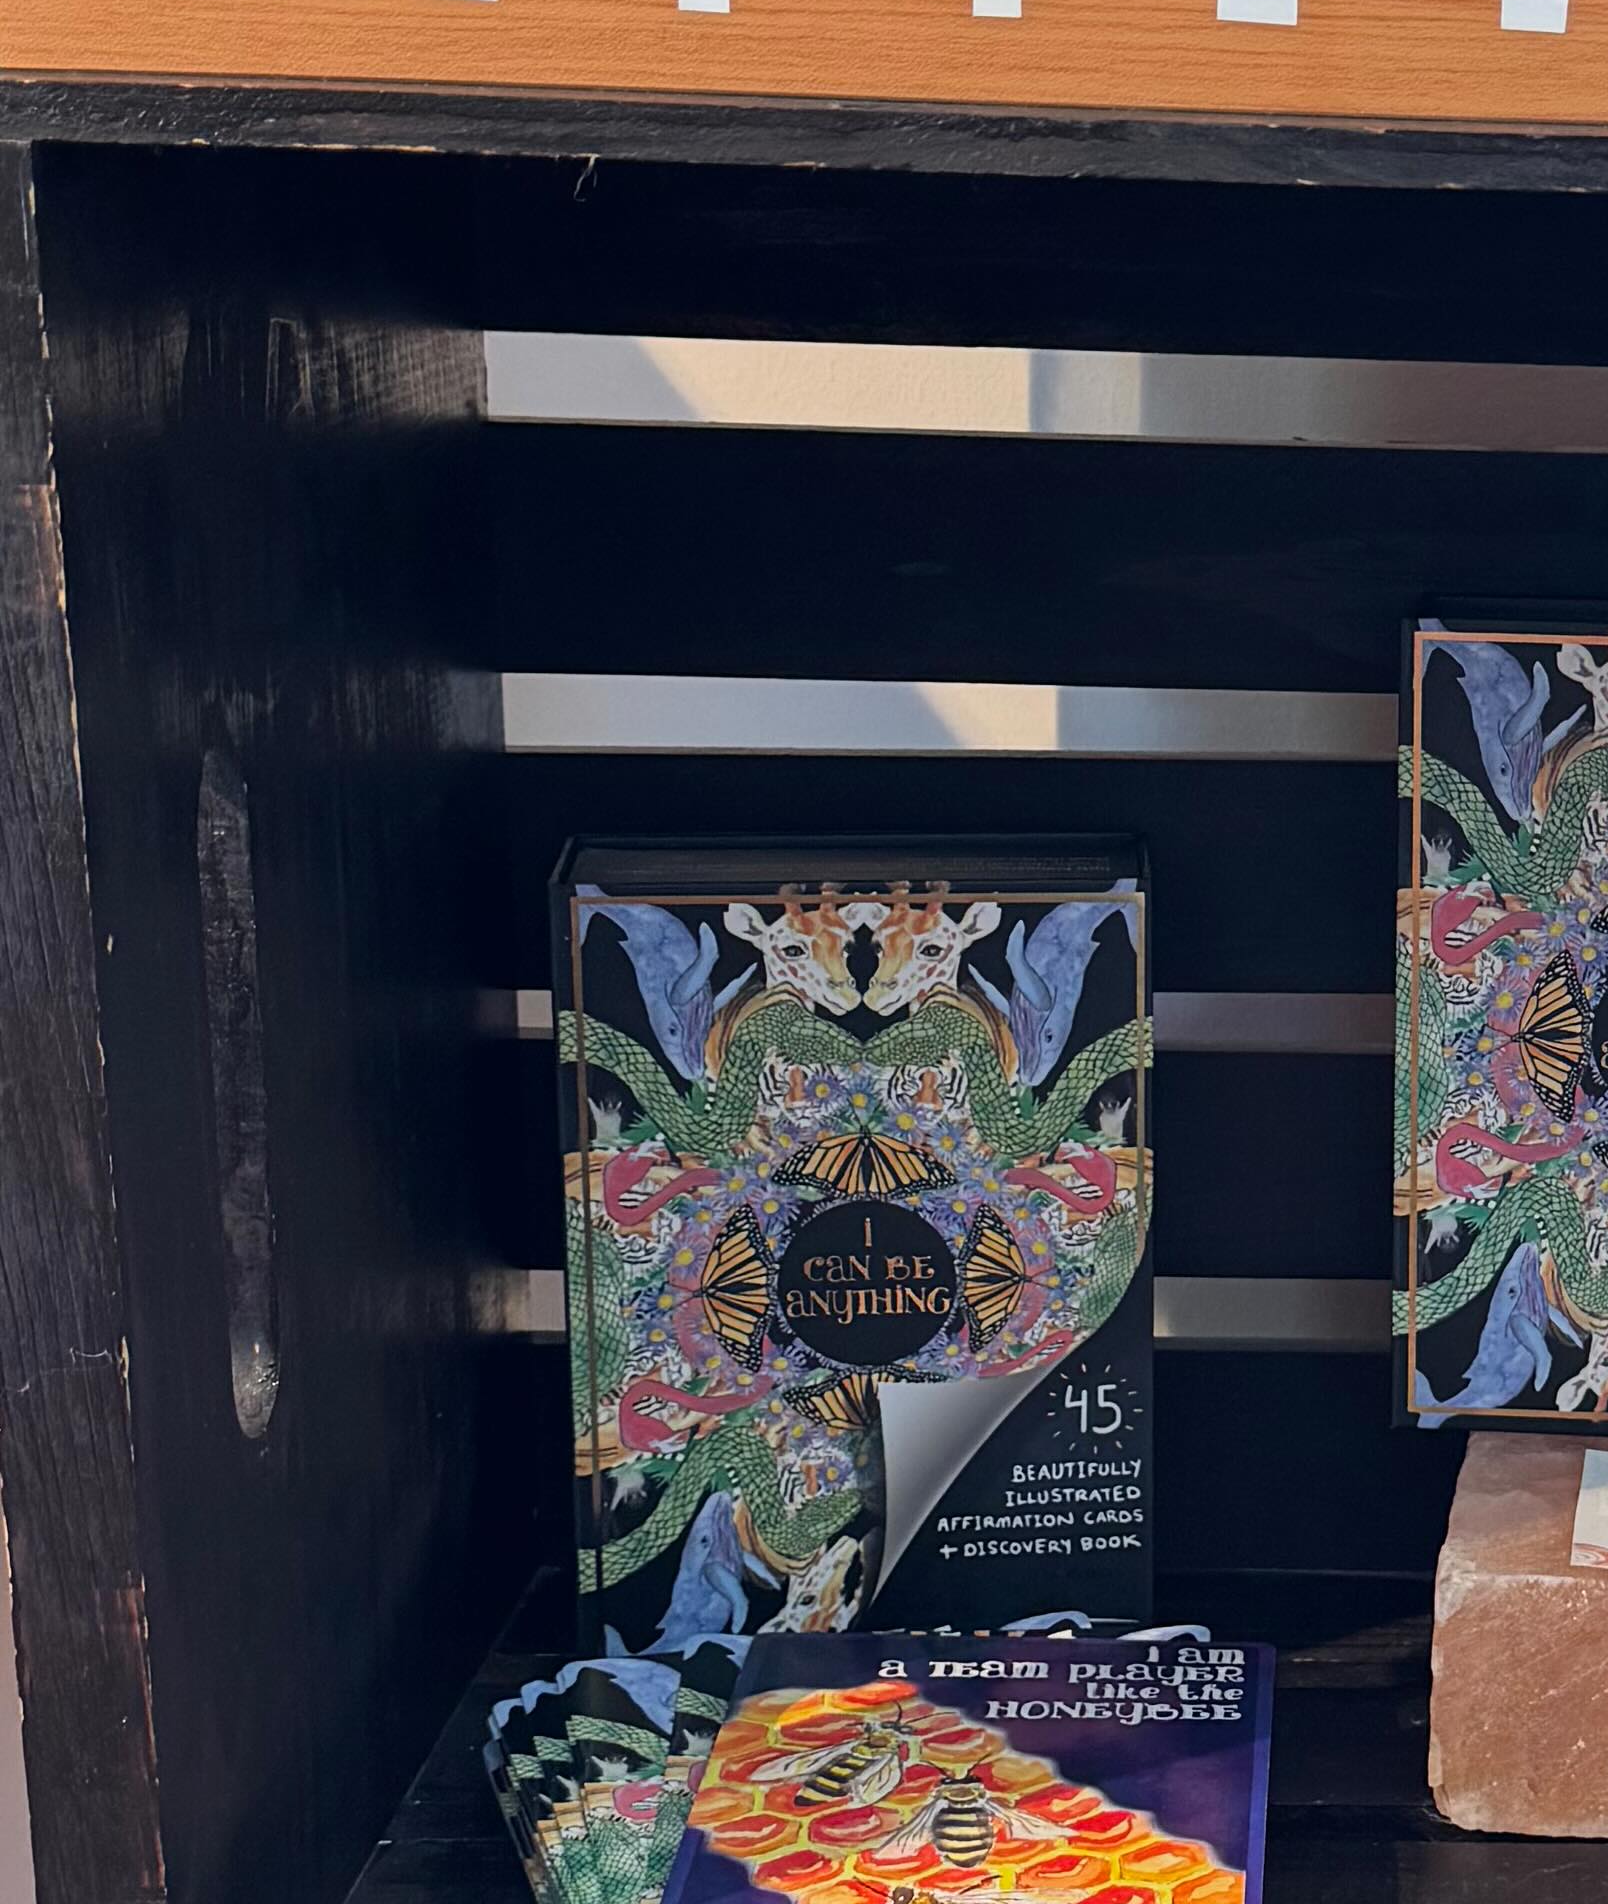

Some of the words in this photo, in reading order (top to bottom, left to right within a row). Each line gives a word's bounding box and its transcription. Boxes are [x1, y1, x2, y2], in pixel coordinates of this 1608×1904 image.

[886, 1256, 934, 1280] BE
[1065, 1384, 1121, 1434] 45
[1012, 1459, 1141, 1482] BEAUTIFULLY
[1006, 1486, 1140, 1506] ILLUSTRATED
[938, 1512, 1074, 1531] AFFIRMATION
[1084, 1509, 1143, 1524] CARDS
[964, 1539, 1071, 1556] DISCOVERY
[1081, 1535, 1141, 1551] BOOK
[878, 1660, 907, 1678] a
[1086, 1683, 1159, 1700] like
[1178, 1683, 1242, 1701] the
